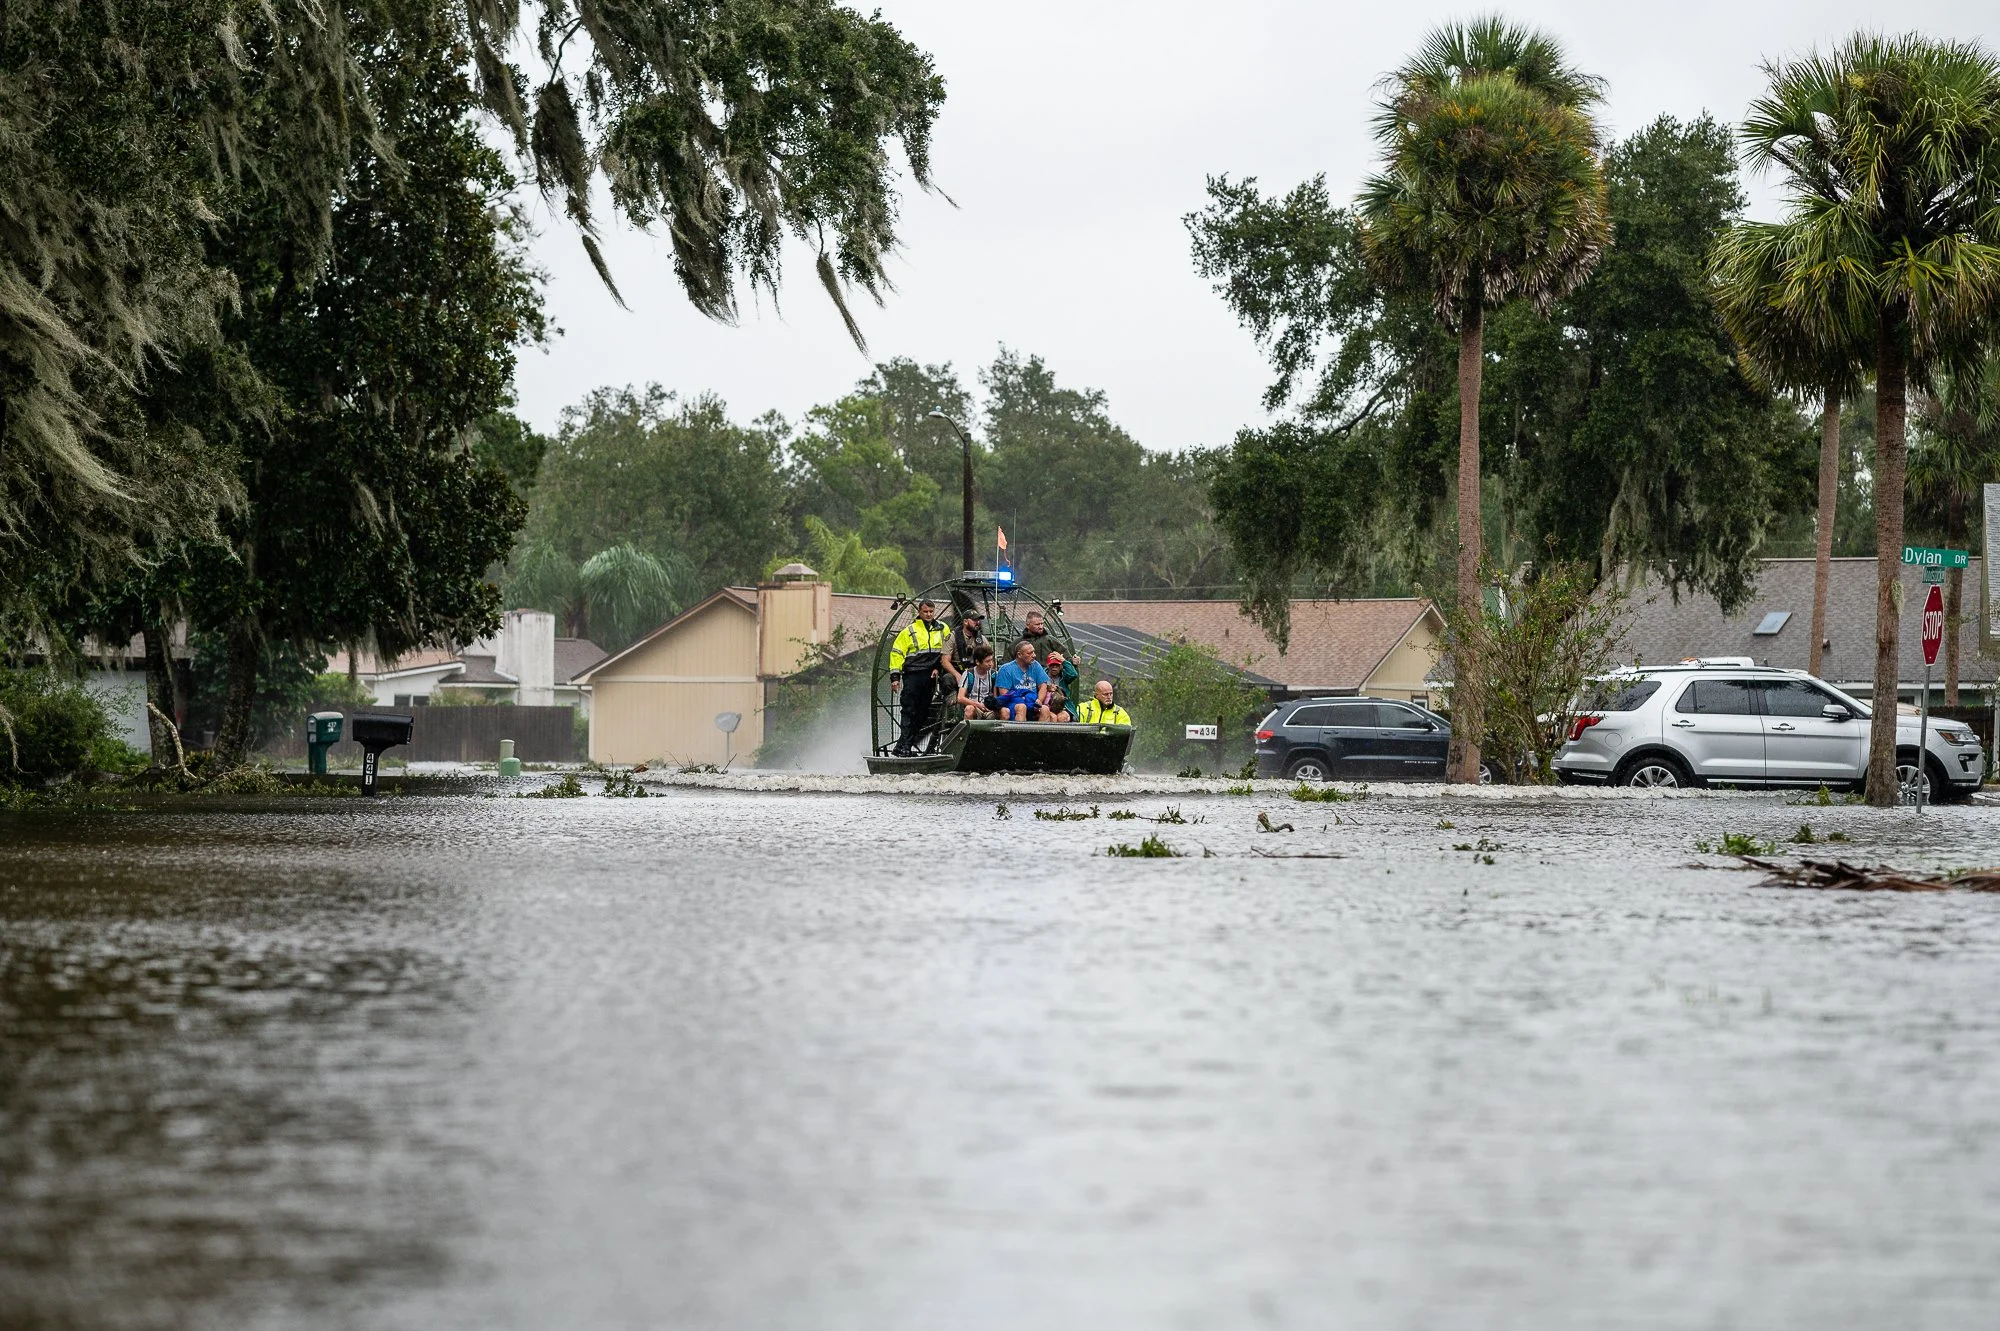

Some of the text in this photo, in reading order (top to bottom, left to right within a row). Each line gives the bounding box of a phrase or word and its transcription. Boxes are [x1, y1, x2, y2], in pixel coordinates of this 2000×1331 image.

[1905, 547, 1967, 565] Dylan DR
[1923, 610, 1942, 640] STOP
[1200, 727, 1216, 736] 434
[365, 753, 374, 785] 441
